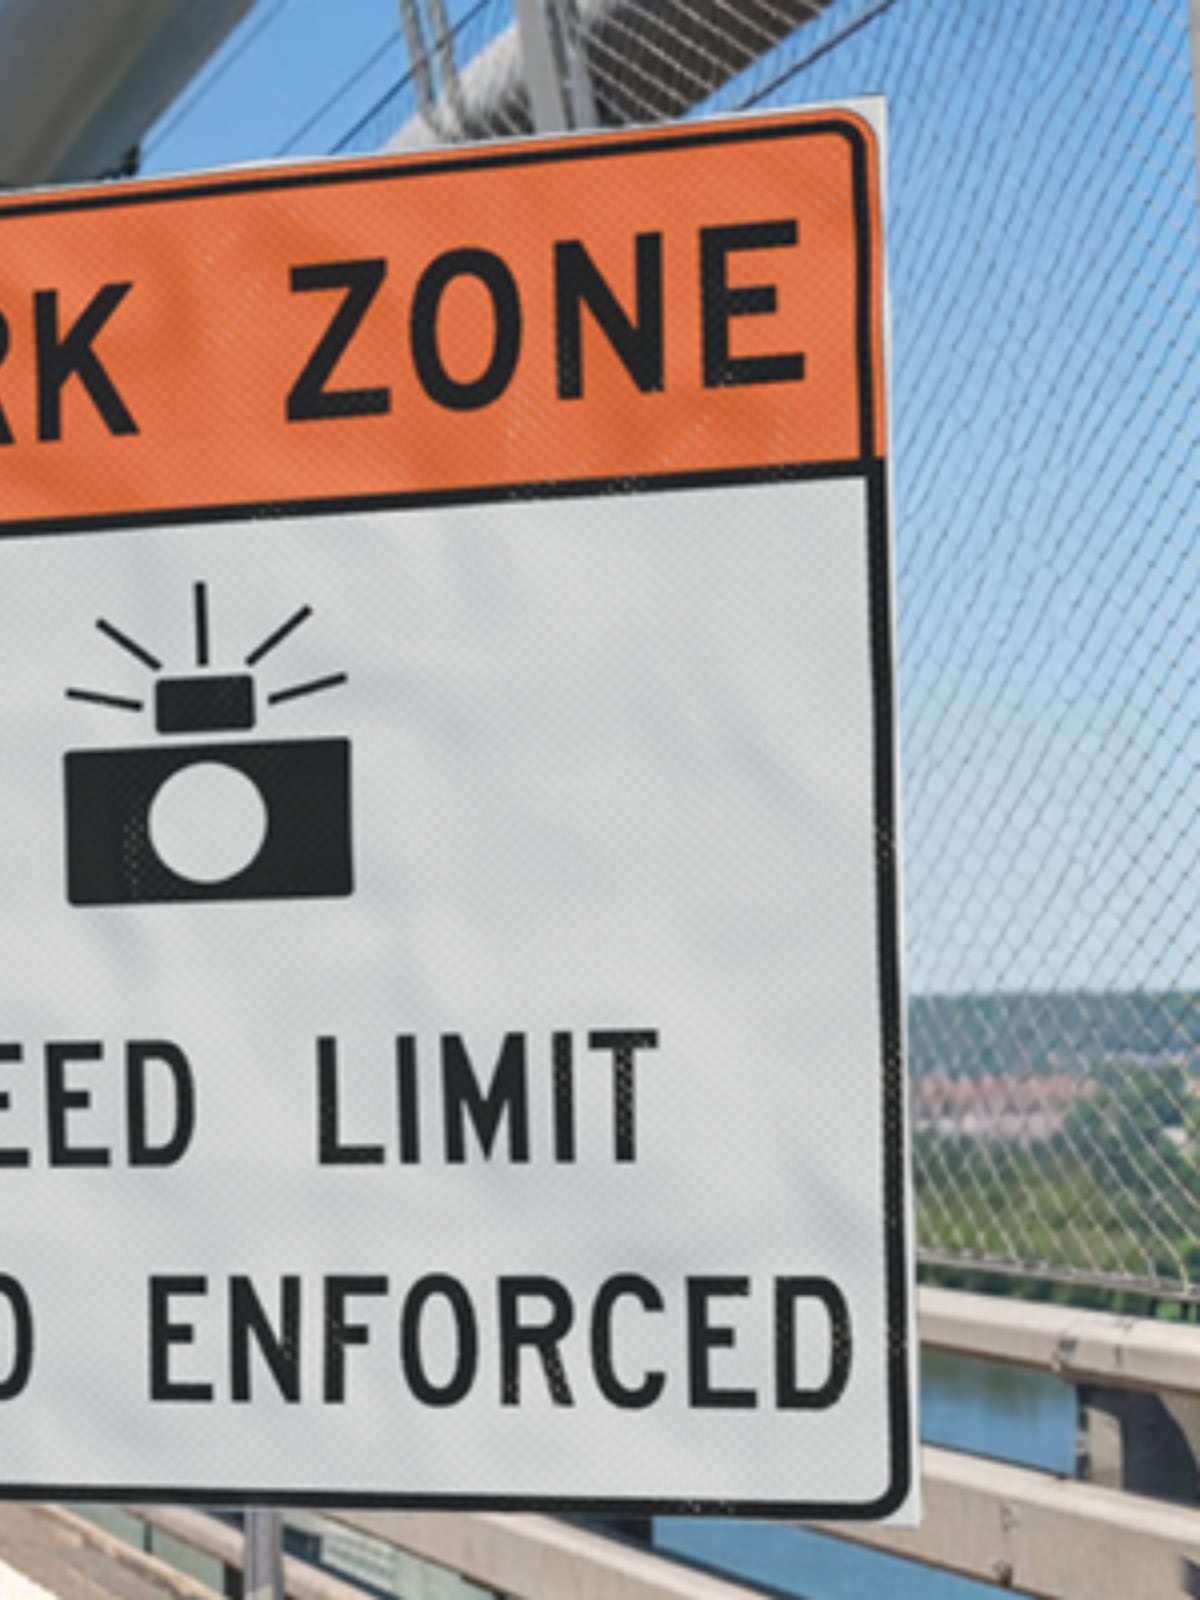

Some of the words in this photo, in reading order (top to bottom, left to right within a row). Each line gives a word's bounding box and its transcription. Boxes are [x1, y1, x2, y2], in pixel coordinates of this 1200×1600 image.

[285, 218, 806, 423] ZONE
[316, 1029, 658, 1165] LIMIT
[149, 1274, 852, 1409] ENFORCED
